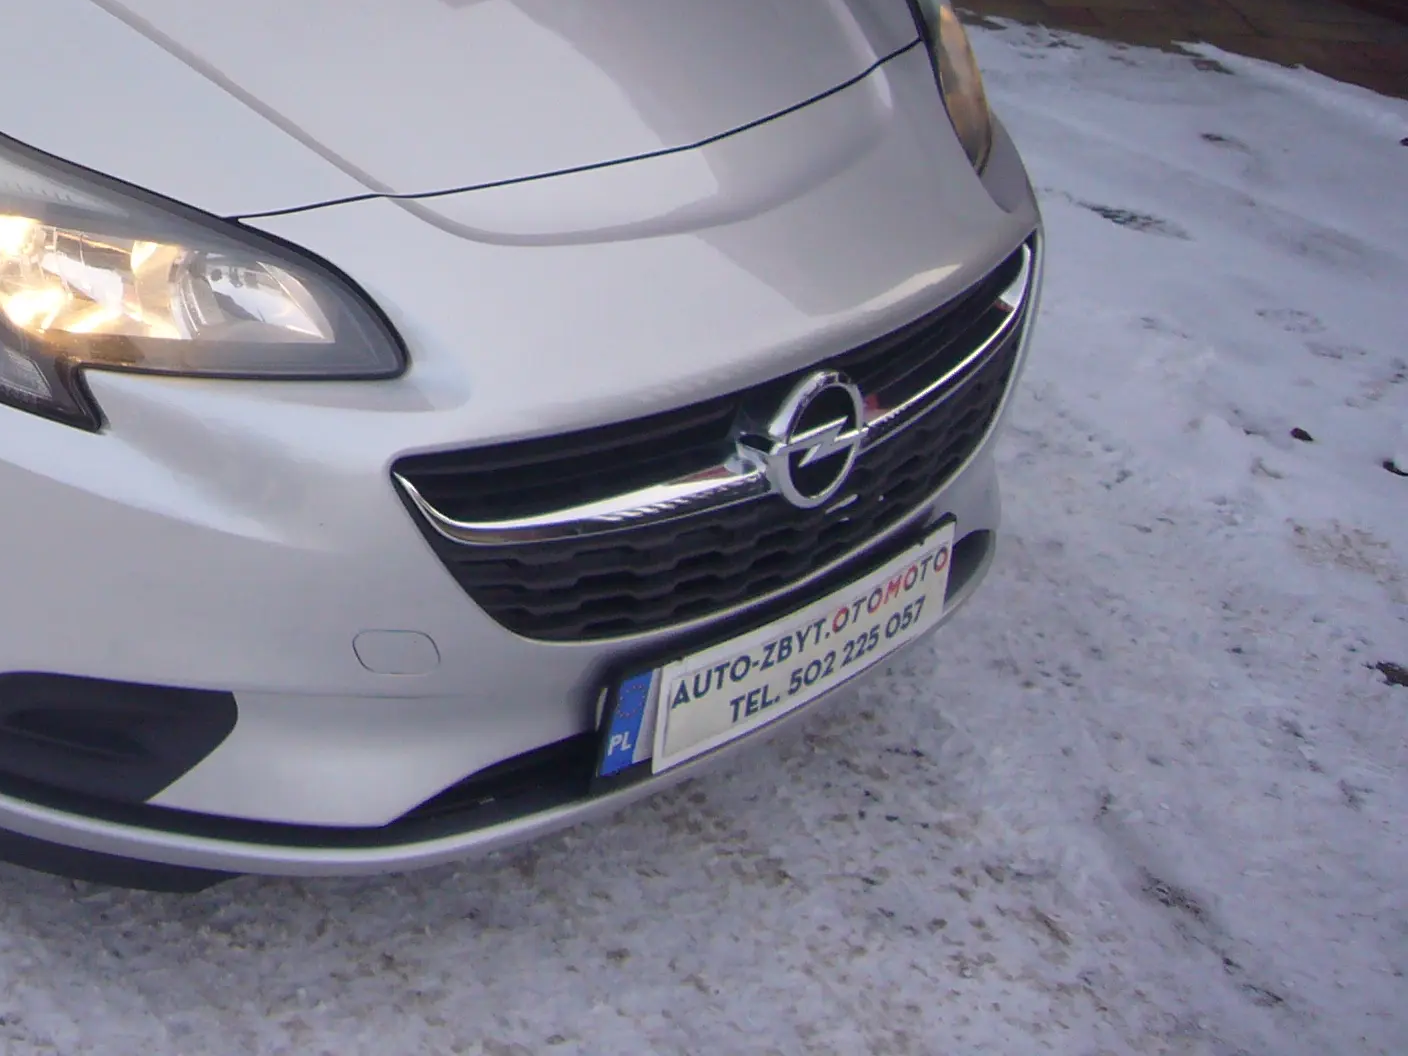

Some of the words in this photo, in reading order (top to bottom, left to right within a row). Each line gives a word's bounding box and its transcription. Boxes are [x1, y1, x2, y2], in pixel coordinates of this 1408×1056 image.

[671, 545, 949, 710] AUTO-ZBYT.OTOMOTO
[729, 683, 781, 723] TEL.
[787, 650, 837, 695] 502
[840, 624, 881, 668] 225
[885, 595, 926, 639] 057
[607, 731, 632, 757] PL
